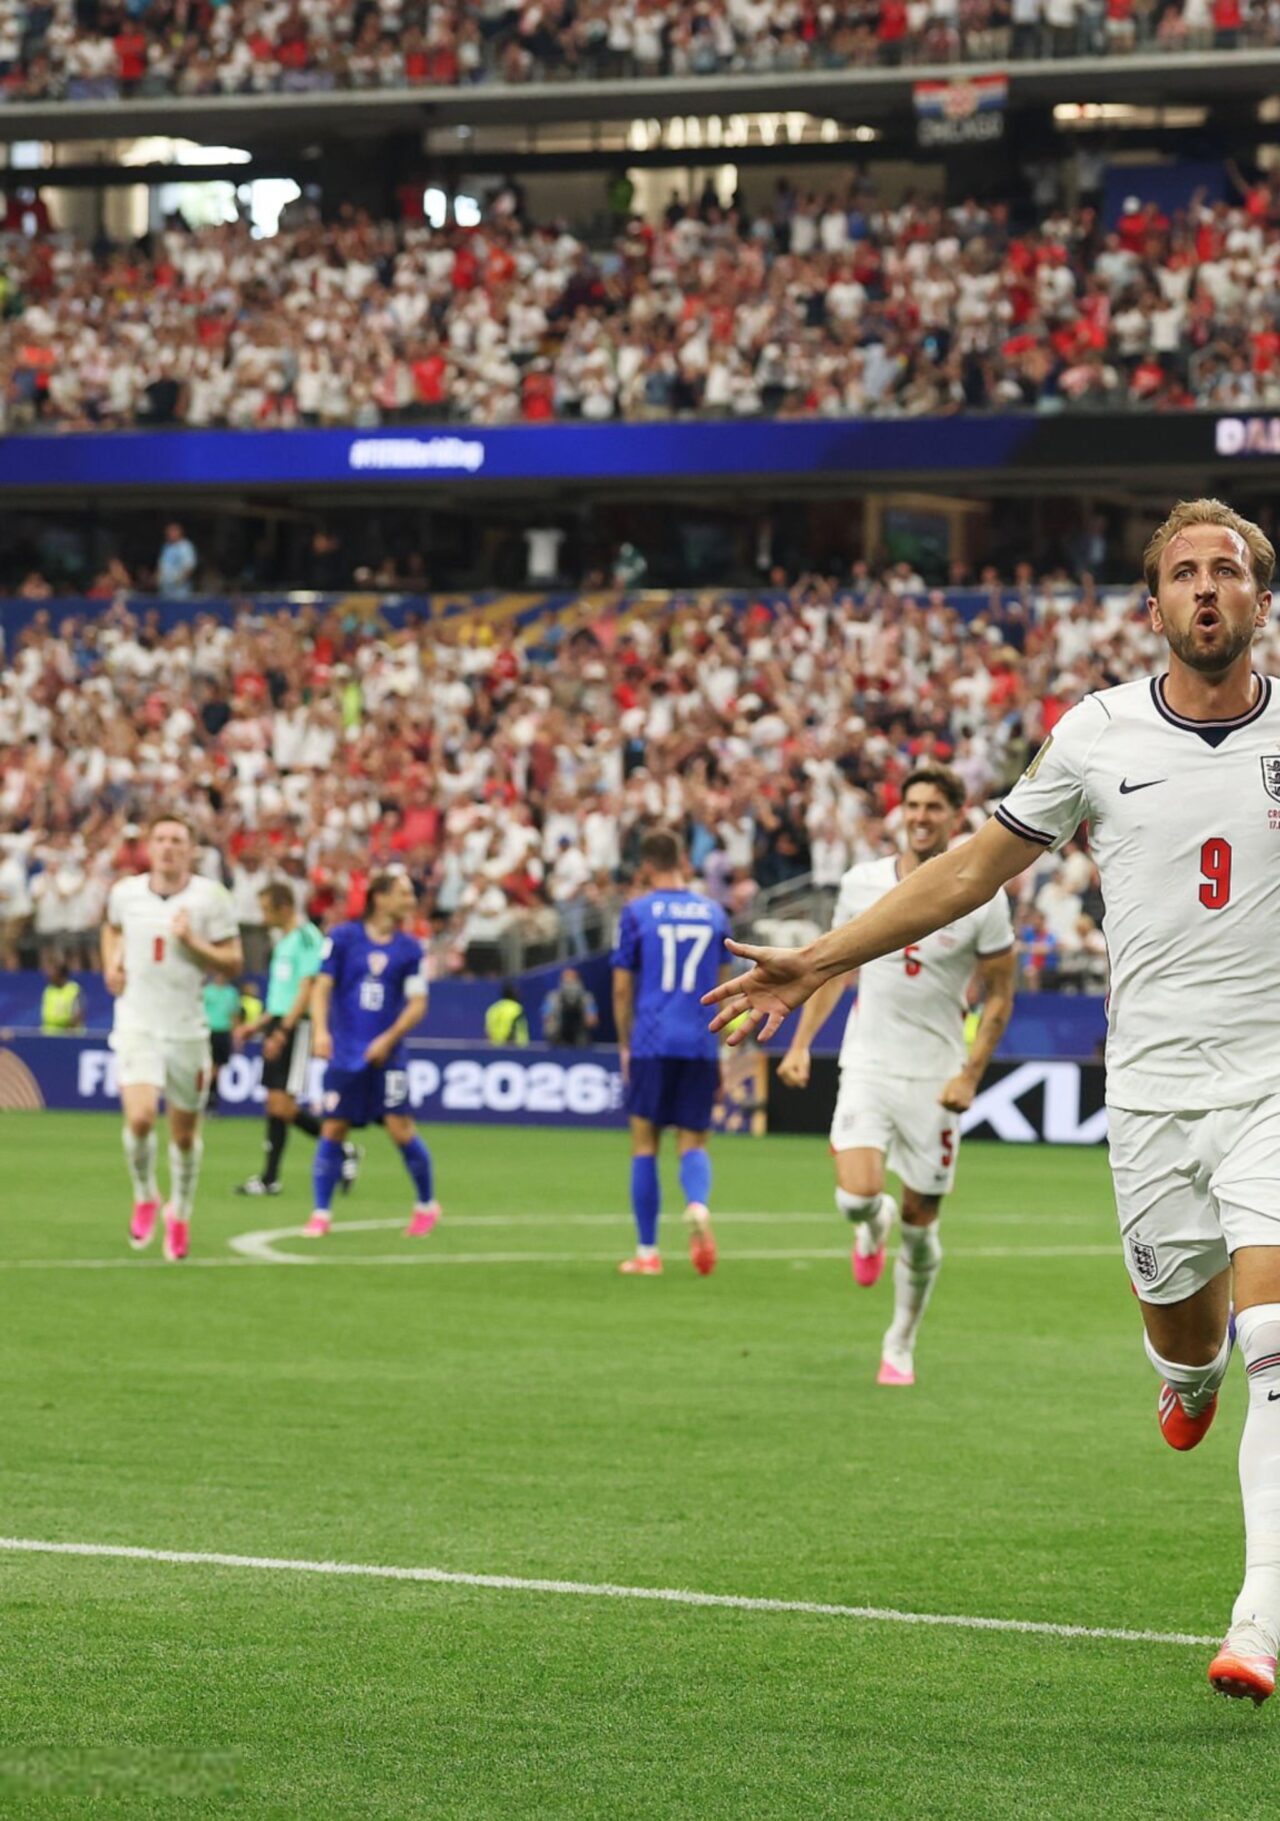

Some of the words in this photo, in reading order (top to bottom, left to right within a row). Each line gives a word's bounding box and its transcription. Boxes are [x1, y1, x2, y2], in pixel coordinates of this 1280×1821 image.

[1199, 837, 1232, 910] 9
[657, 923, 714, 993] 17
[441, 1059, 609, 1114] 2026
